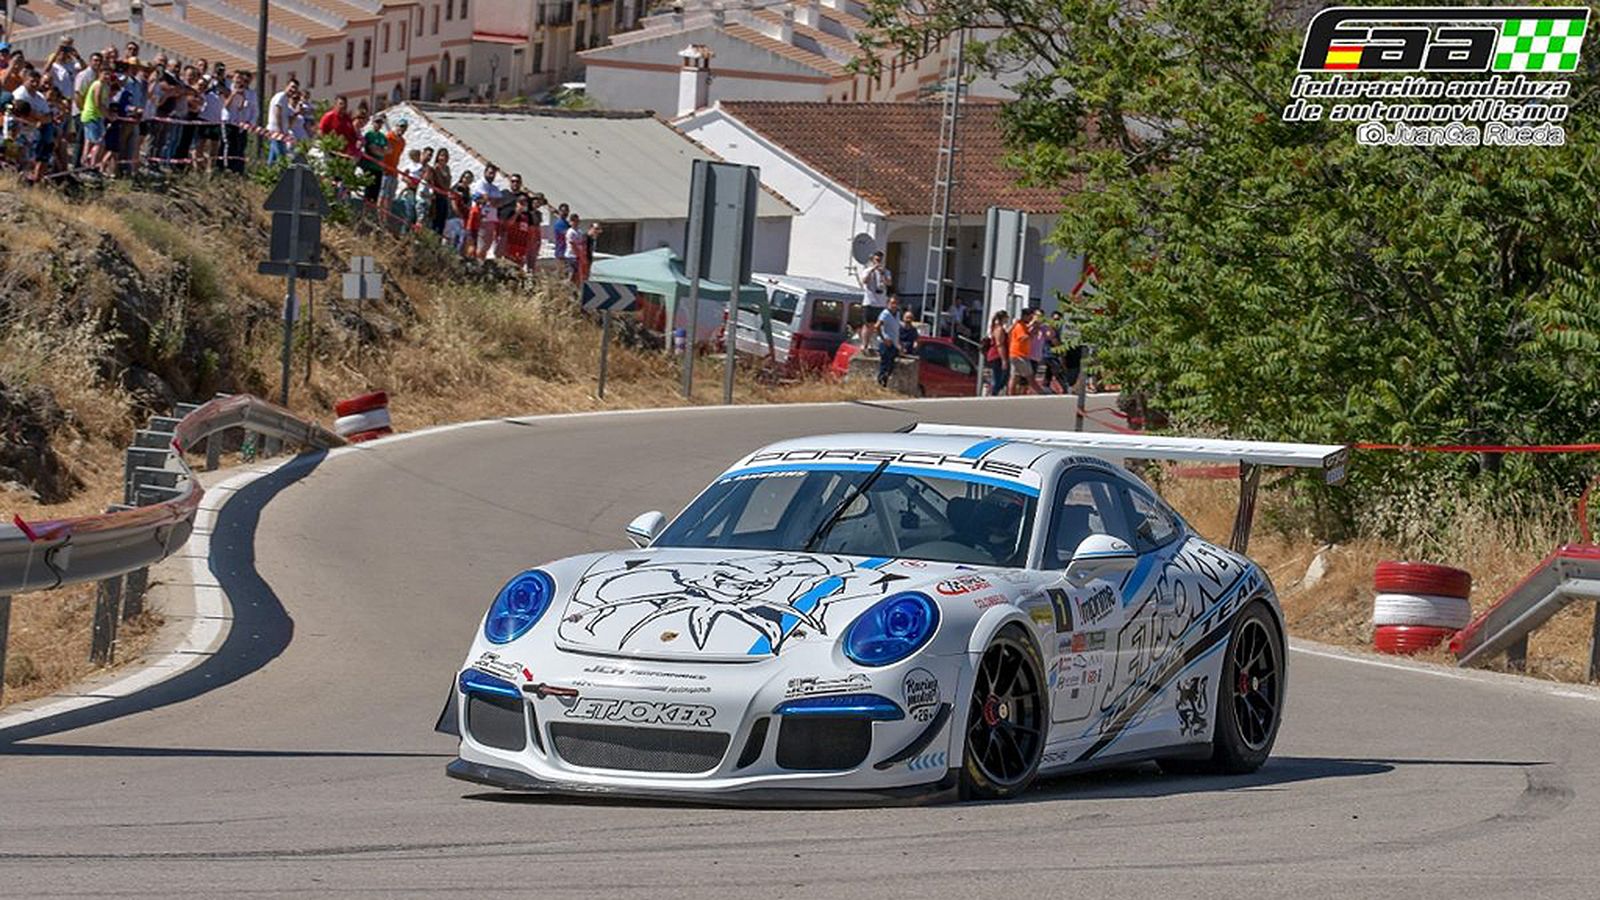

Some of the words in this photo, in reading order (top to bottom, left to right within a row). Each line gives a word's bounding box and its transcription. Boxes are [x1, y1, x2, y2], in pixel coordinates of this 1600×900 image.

[745, 449, 1025, 478] PORSCHE
[1055, 593, 1067, 626] 1
[1200, 570, 1263, 637] TEAM
[564, 697, 716, 728] JETJOKER
